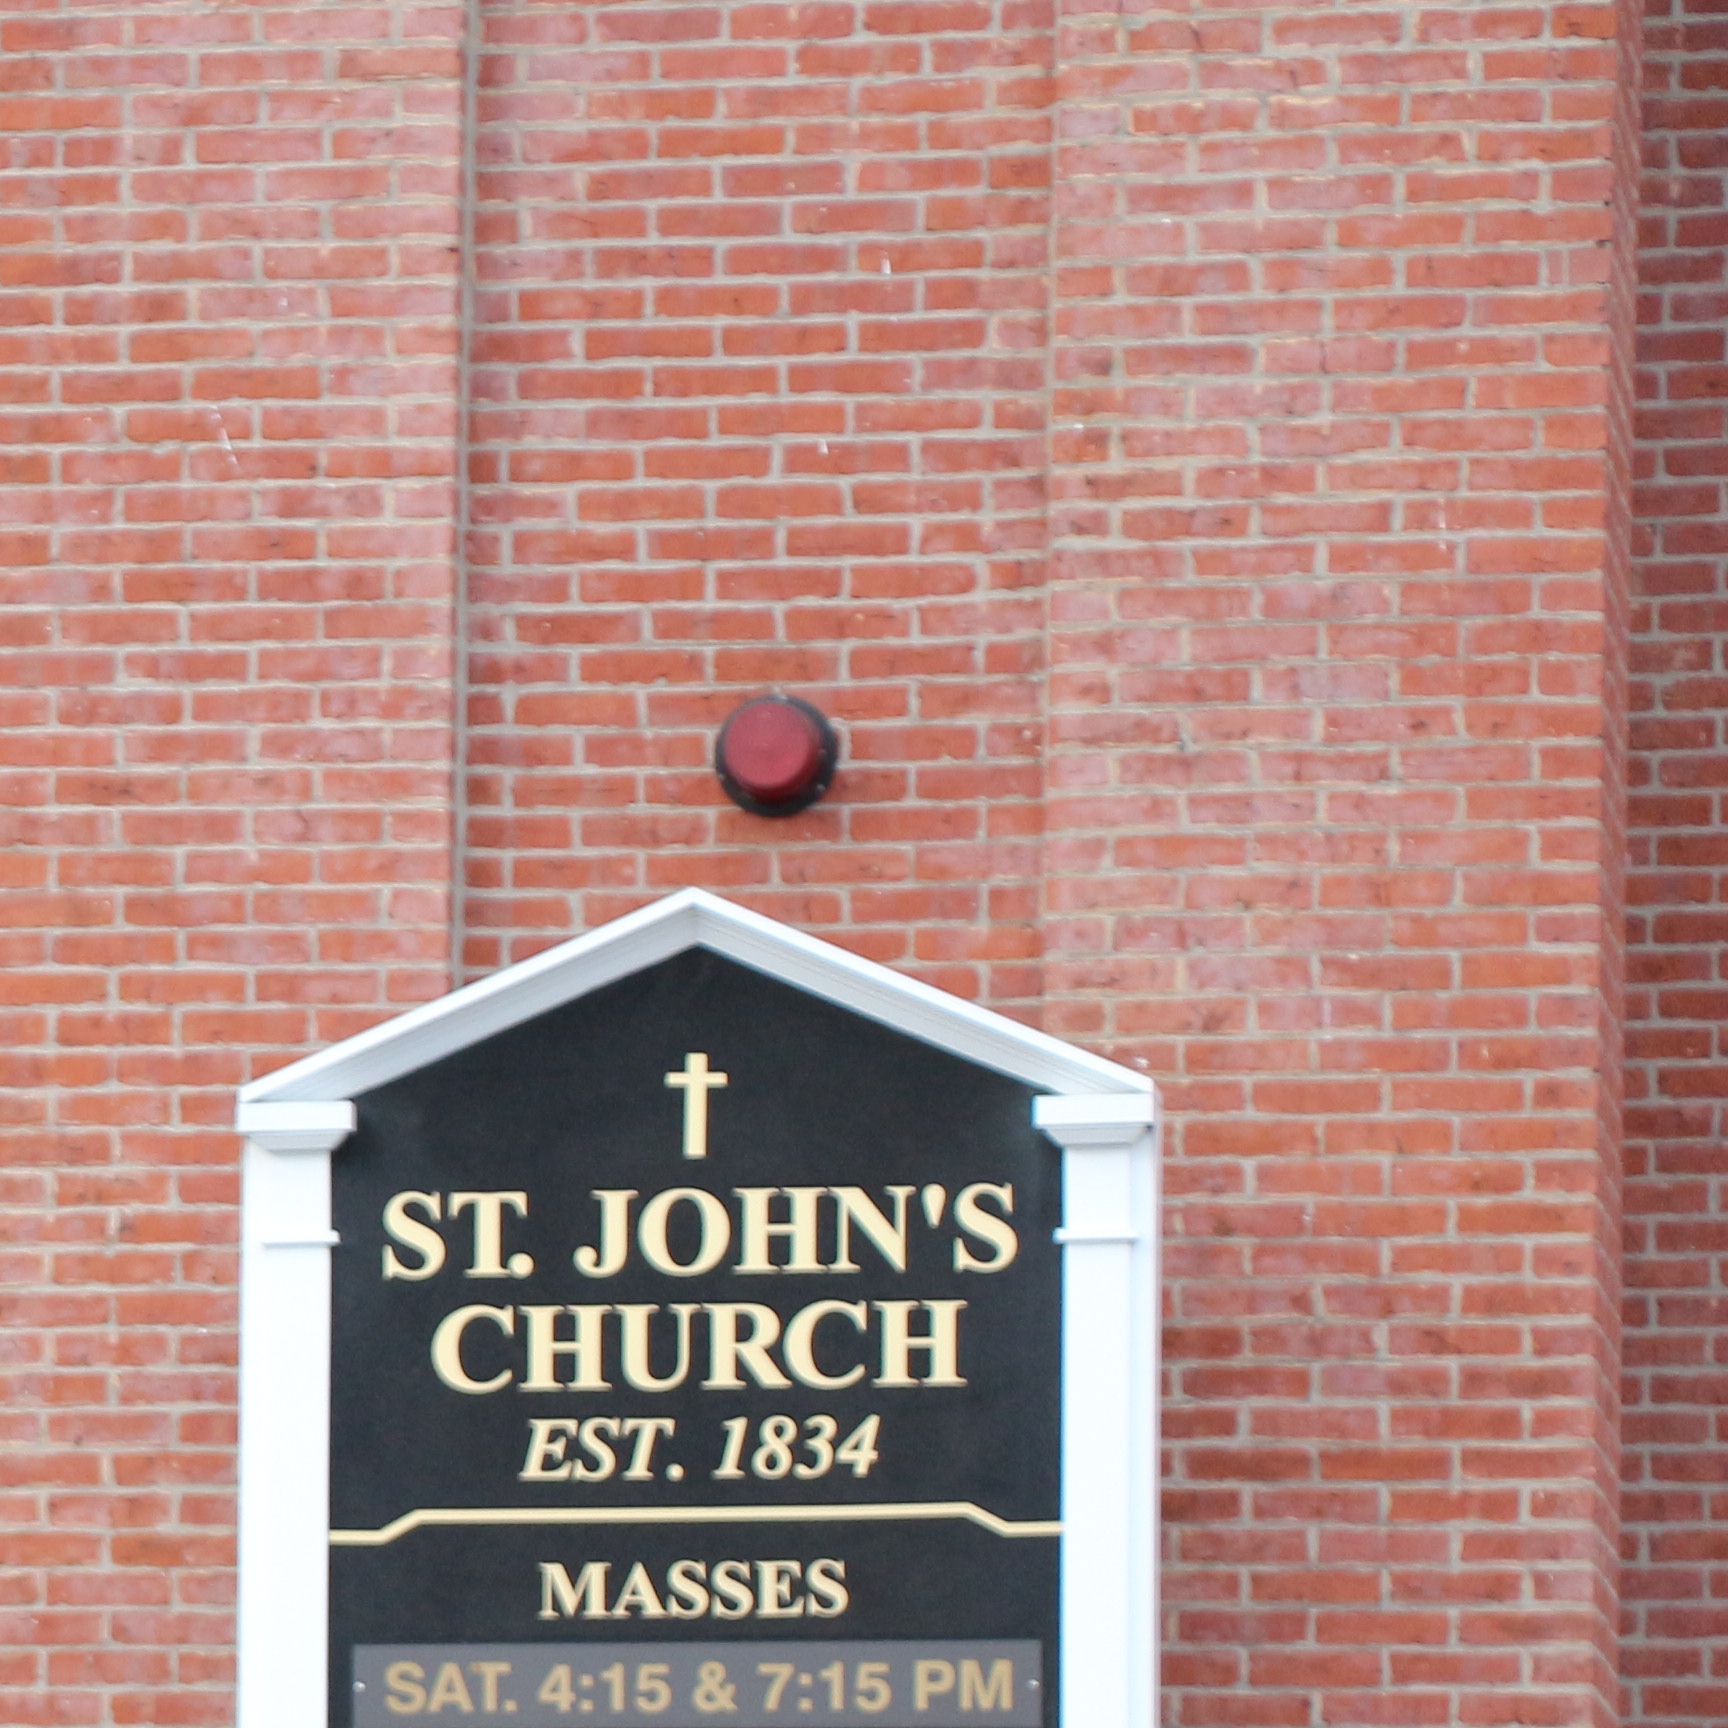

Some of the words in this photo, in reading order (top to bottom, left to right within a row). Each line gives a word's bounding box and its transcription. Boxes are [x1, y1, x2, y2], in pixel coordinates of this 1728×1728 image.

[383, 1190, 534, 1280] ST.
[574, 1182, 1019, 1278] JOHN'S
[430, 1299, 969, 1394] CHURCH
[519, 1417, 685, 1482] EST.
[714, 1414, 882, 1480] 1834
[539, 1558, 850, 1620] MASSES
[384, 1660, 519, 1716] SAT.
[537, 1661, 673, 1715] 4:15
[691, 1660, 740, 1714] &
[757, 1661, 893, 1714] 7:15
[914, 1658, 1014, 1713] PM
